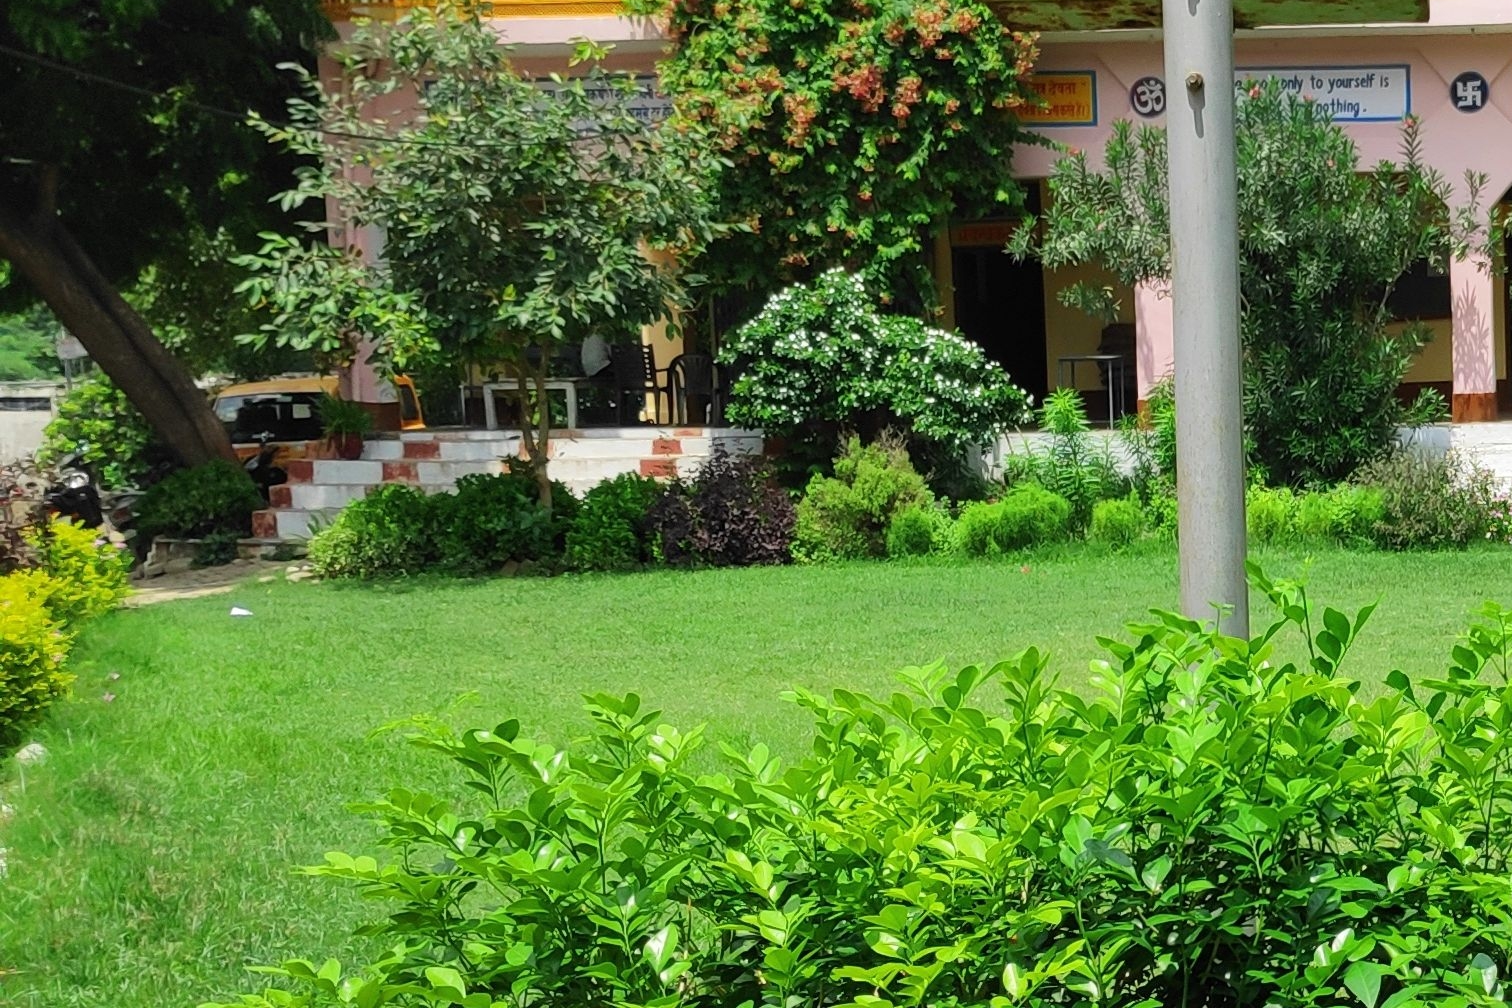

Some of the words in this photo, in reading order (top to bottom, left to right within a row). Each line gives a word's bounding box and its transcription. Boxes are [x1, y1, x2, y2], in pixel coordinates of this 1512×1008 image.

[1310, 75, 1323, 90] to
[1328, 73, 1375, 93] yourself
[1380, 76, 1389, 88] is
